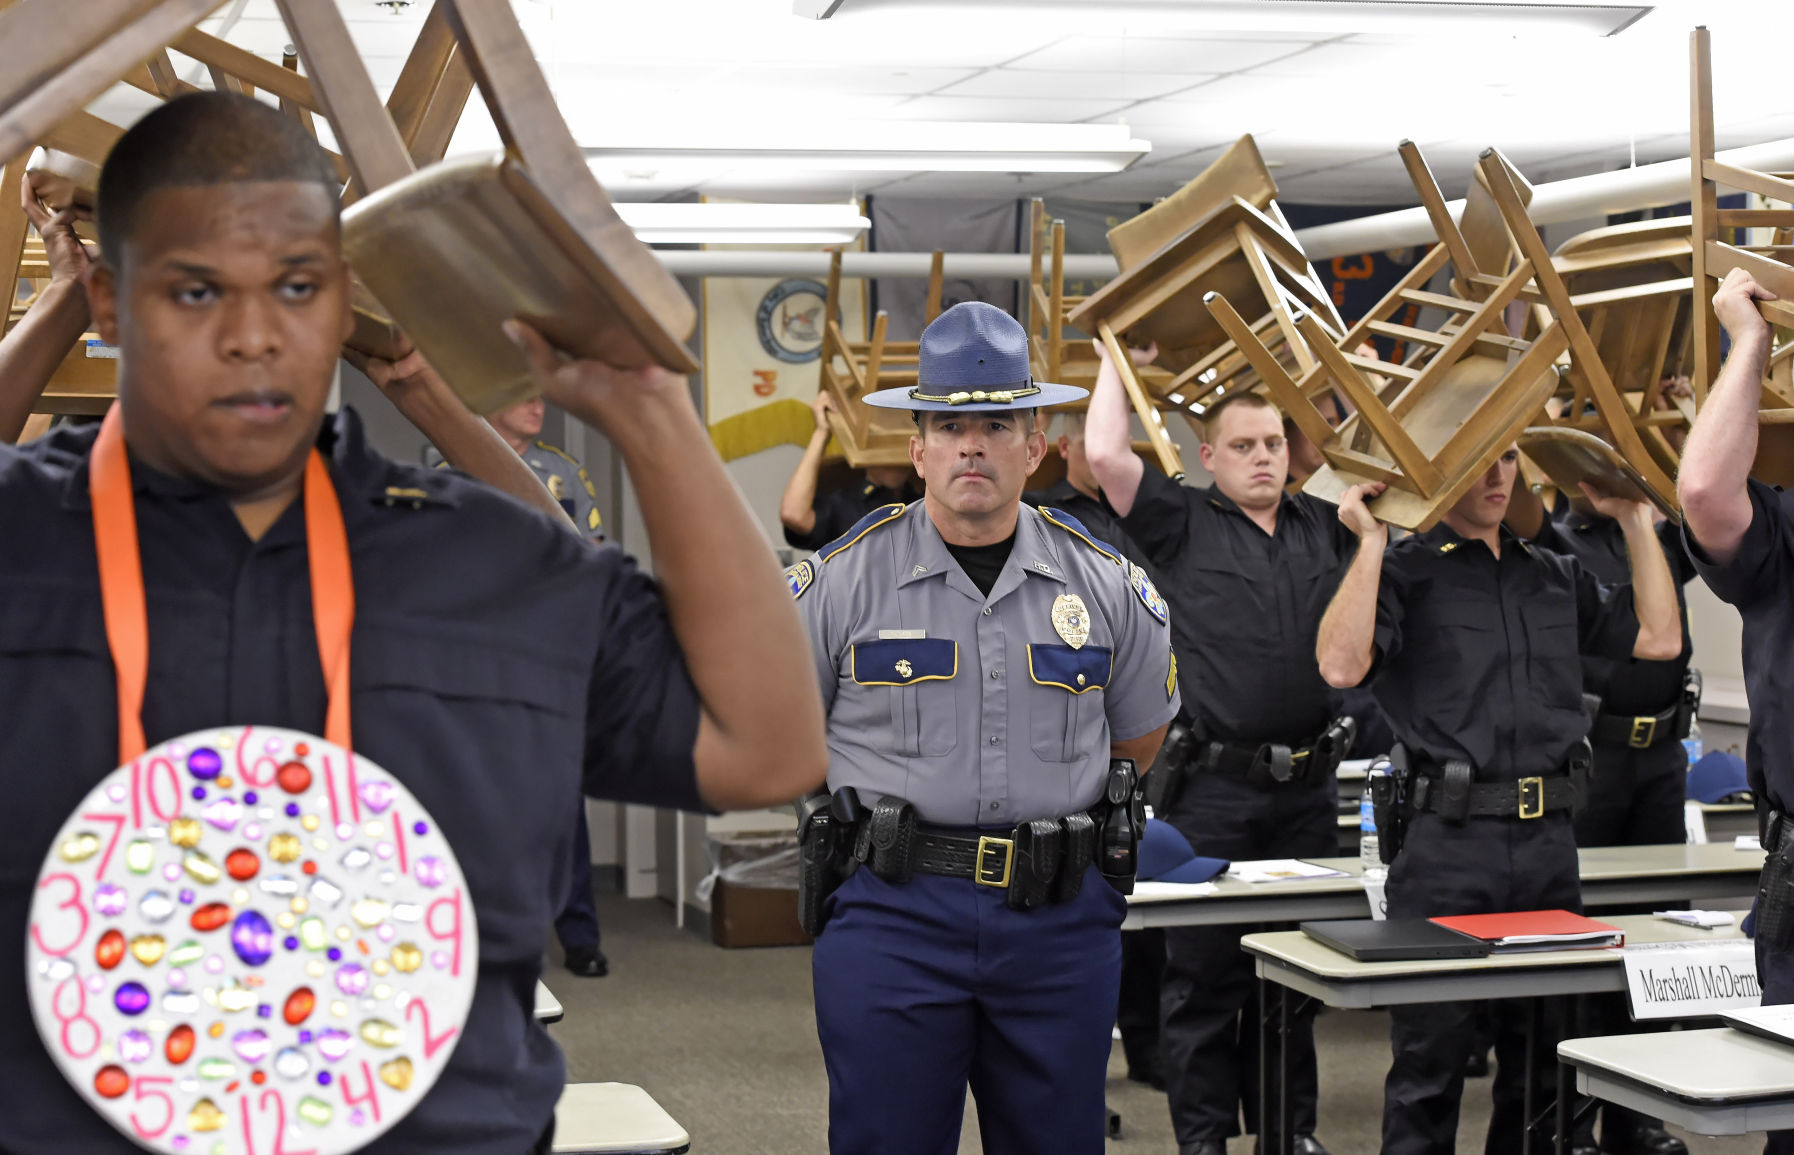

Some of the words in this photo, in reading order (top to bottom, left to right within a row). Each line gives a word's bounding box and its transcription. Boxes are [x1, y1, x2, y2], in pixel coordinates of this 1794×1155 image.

[236, 727, 281, 788] 6
[323, 752, 359, 826] 11
[131, 757, 182, 829] 10
[83, 813, 126, 881] 7
[392, 811, 407, 874] 1
[31, 872, 90, 957] 3
[425, 887, 461, 977] 9
[52, 974, 101, 1059] 8
[1639, 965, 1700, 1003] Marshall
[405, 998, 459, 1059] 2
[129, 1077, 174, 1139] 5
[239, 1089, 318, 1155] 12
[339, 1060, 380, 1122] 4
